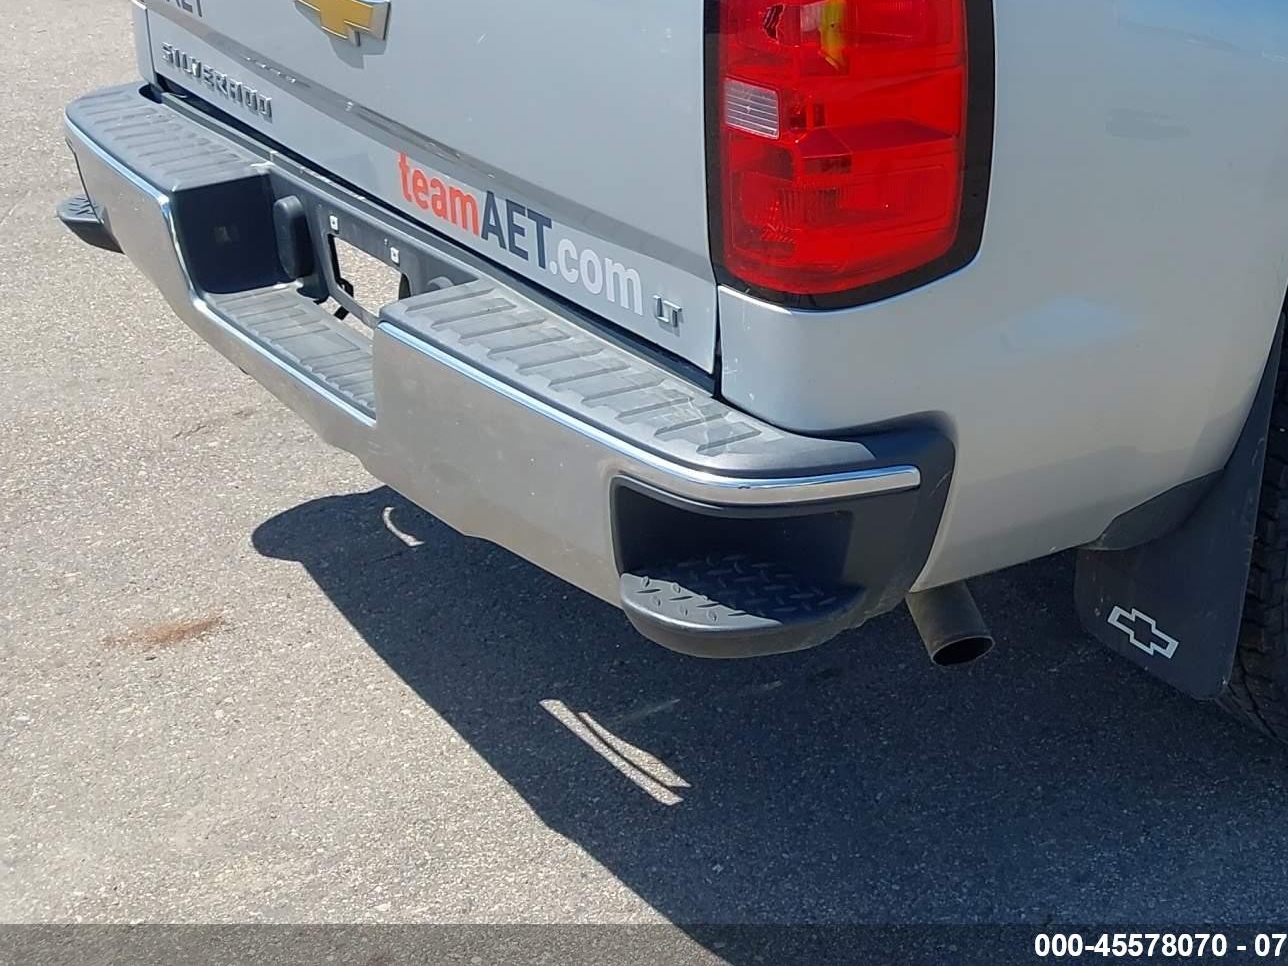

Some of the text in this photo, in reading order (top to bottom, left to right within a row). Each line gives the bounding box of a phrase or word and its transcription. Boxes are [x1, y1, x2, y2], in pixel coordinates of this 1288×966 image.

[160, 41, 273, 123] SILVERADO
[398, 152, 644, 316] teamAET.com
[653, 295, 683, 328] LT
